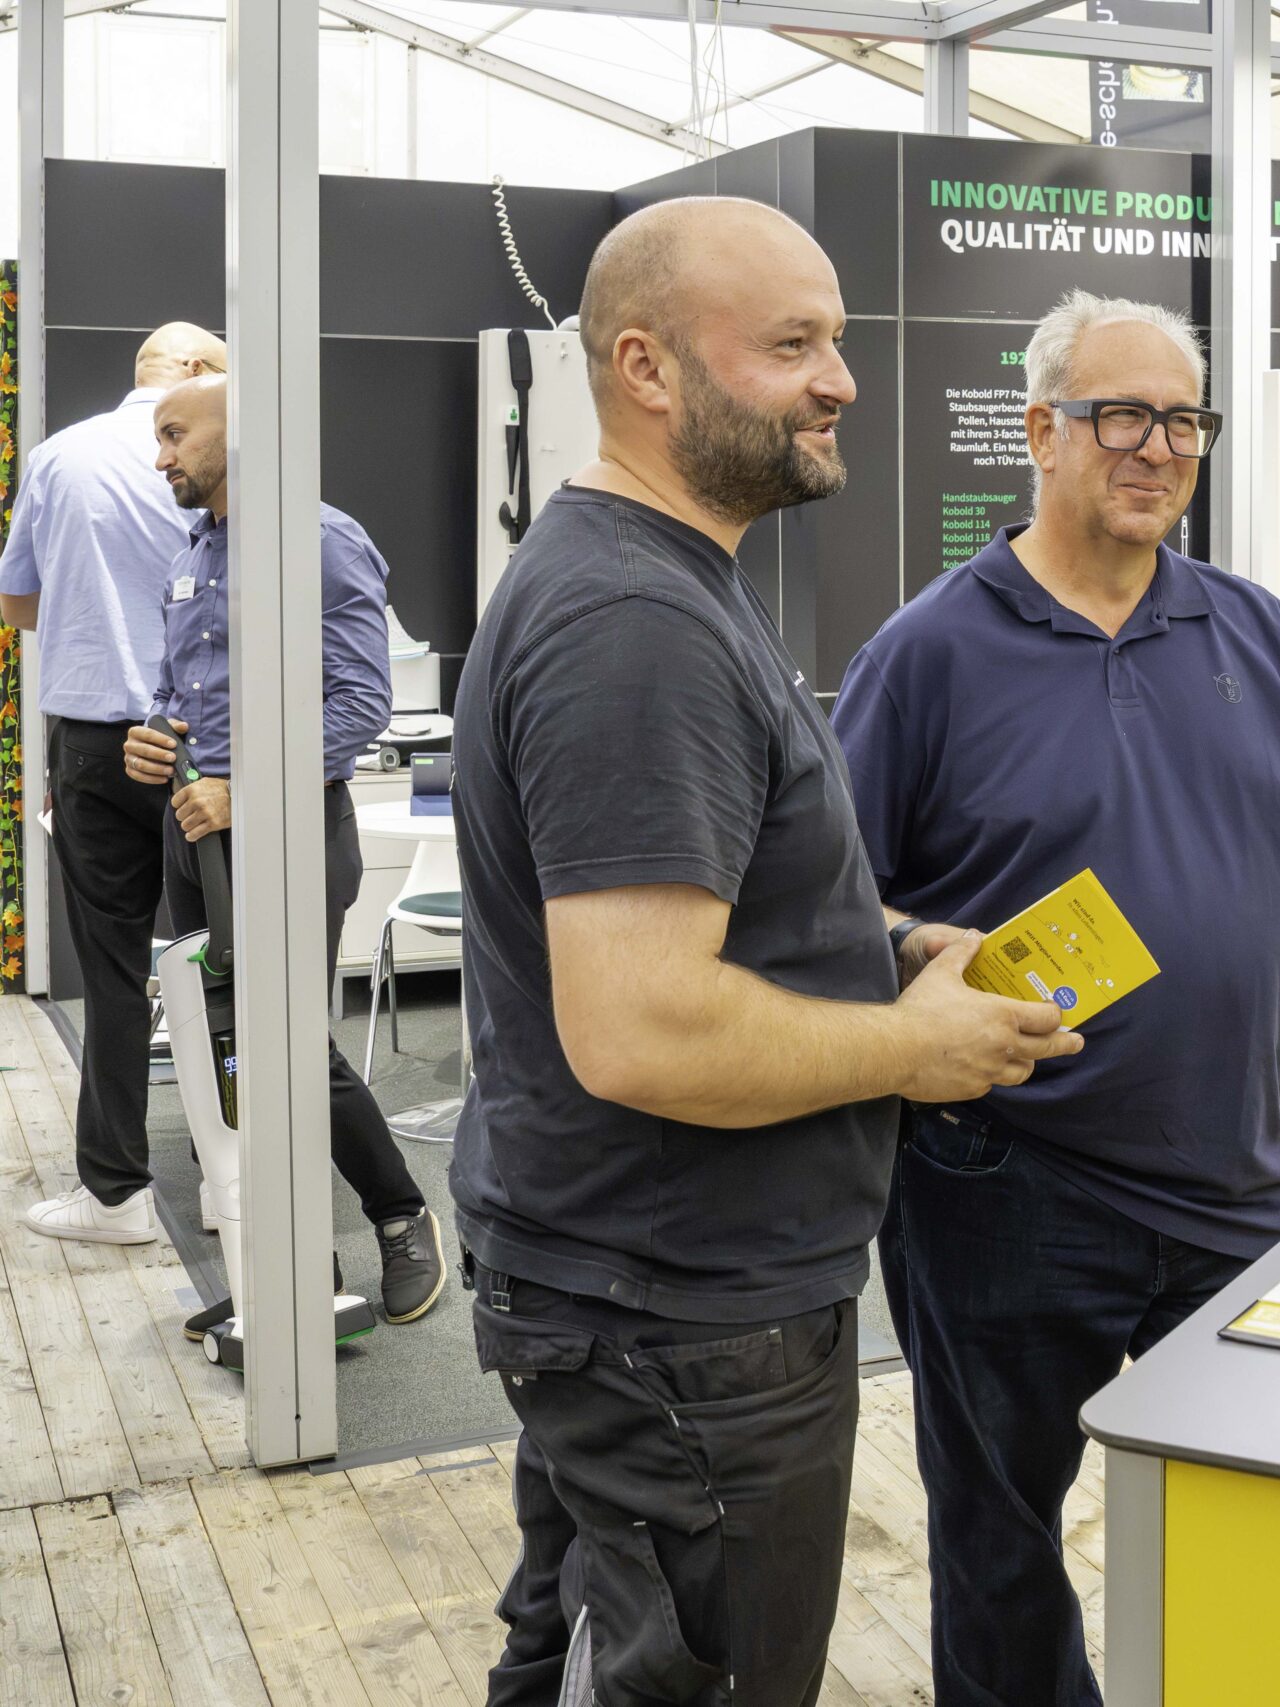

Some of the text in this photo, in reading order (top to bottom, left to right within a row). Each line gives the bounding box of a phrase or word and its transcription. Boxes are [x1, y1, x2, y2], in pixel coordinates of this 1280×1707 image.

[931, 179, 1108, 216] INNOVATIVE
[940, 218, 1086, 254] QUALITÄT
[1092, 226, 1155, 256] UND
[946, 388, 961, 399] Die
[961, 389, 993, 399] Kobold
[994, 389, 1010, 400] FP7
[958, 415, 988, 427] Pollen,
[950, 429, 966, 439] mit
[966, 430, 992, 439] ihrem
[950, 442, 992, 453] Raumluft.
[993, 442, 1007, 452] Ein
[973, 457, 996, 466] noch
[942, 492, 1017, 504] Handstaubsauger
[942, 506, 986, 516] Kobold 30
[942, 519, 991, 529] Kobold 114
[942, 533, 991, 543] Kobold 118
[942, 546, 974, 556] Kobold
